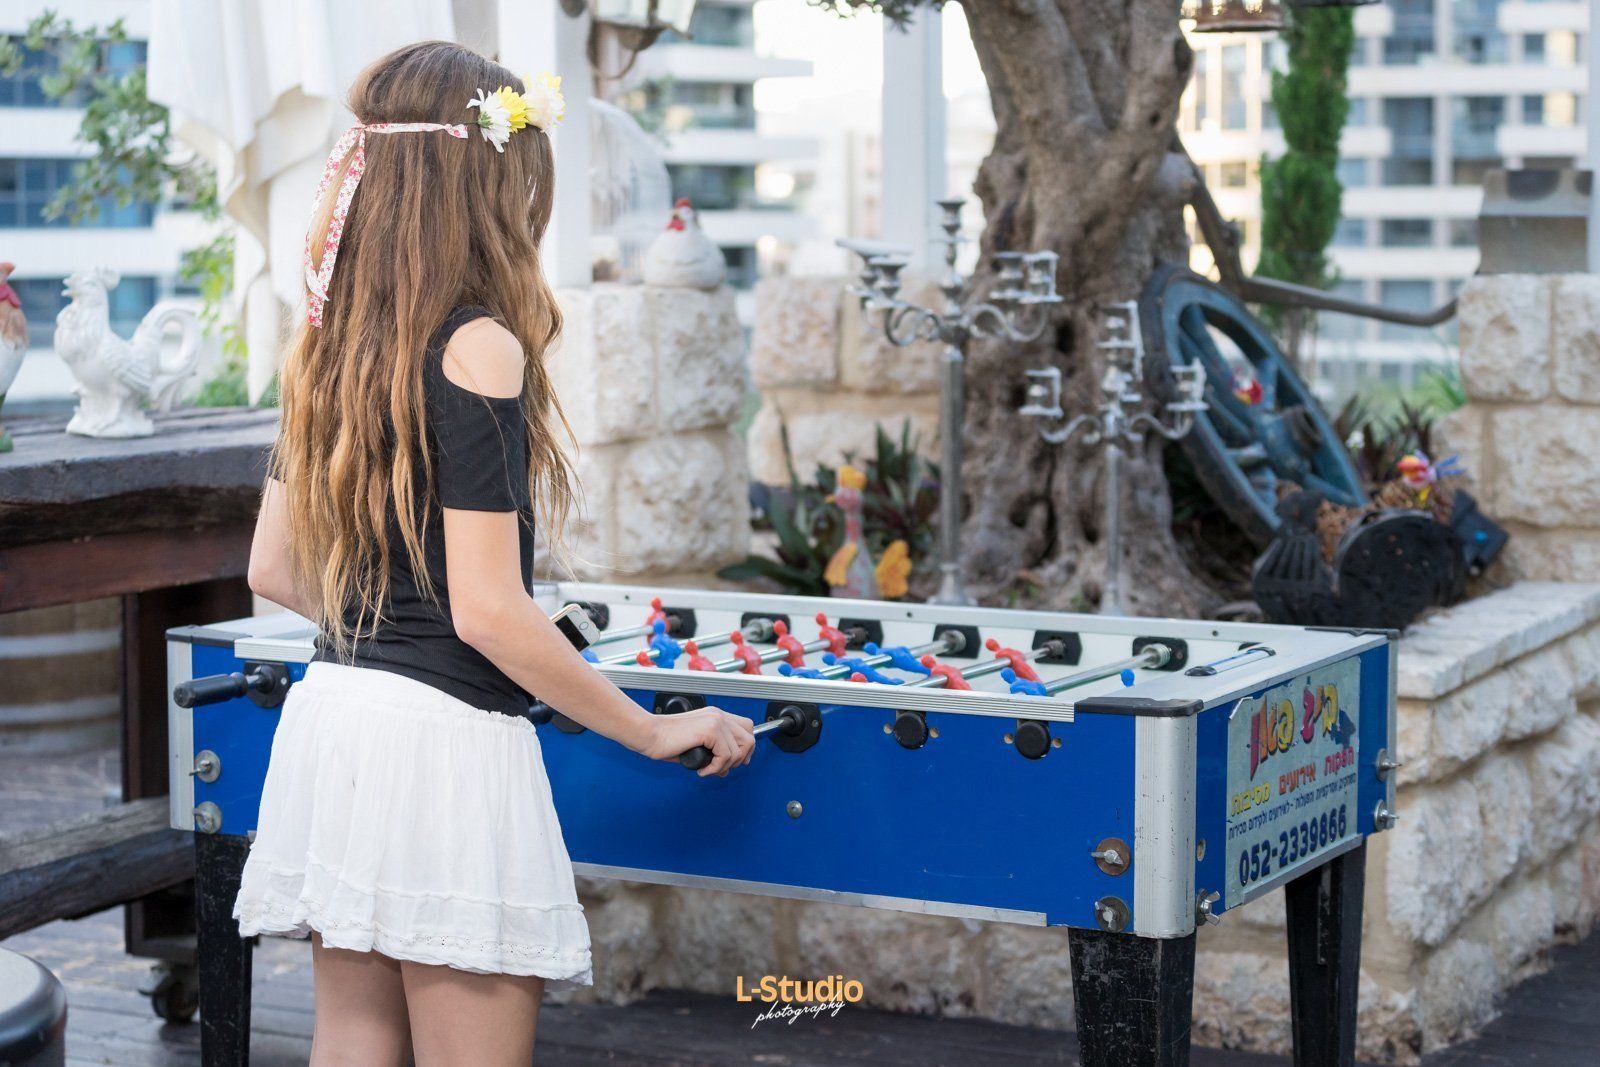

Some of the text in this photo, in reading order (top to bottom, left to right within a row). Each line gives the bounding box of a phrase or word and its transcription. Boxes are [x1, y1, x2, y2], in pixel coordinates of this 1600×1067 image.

[1278, 762, 1317, 796] אירועים
[1231, 782, 1270, 817] מסיבות
[1239, 803, 1347, 887] 052-2339866
